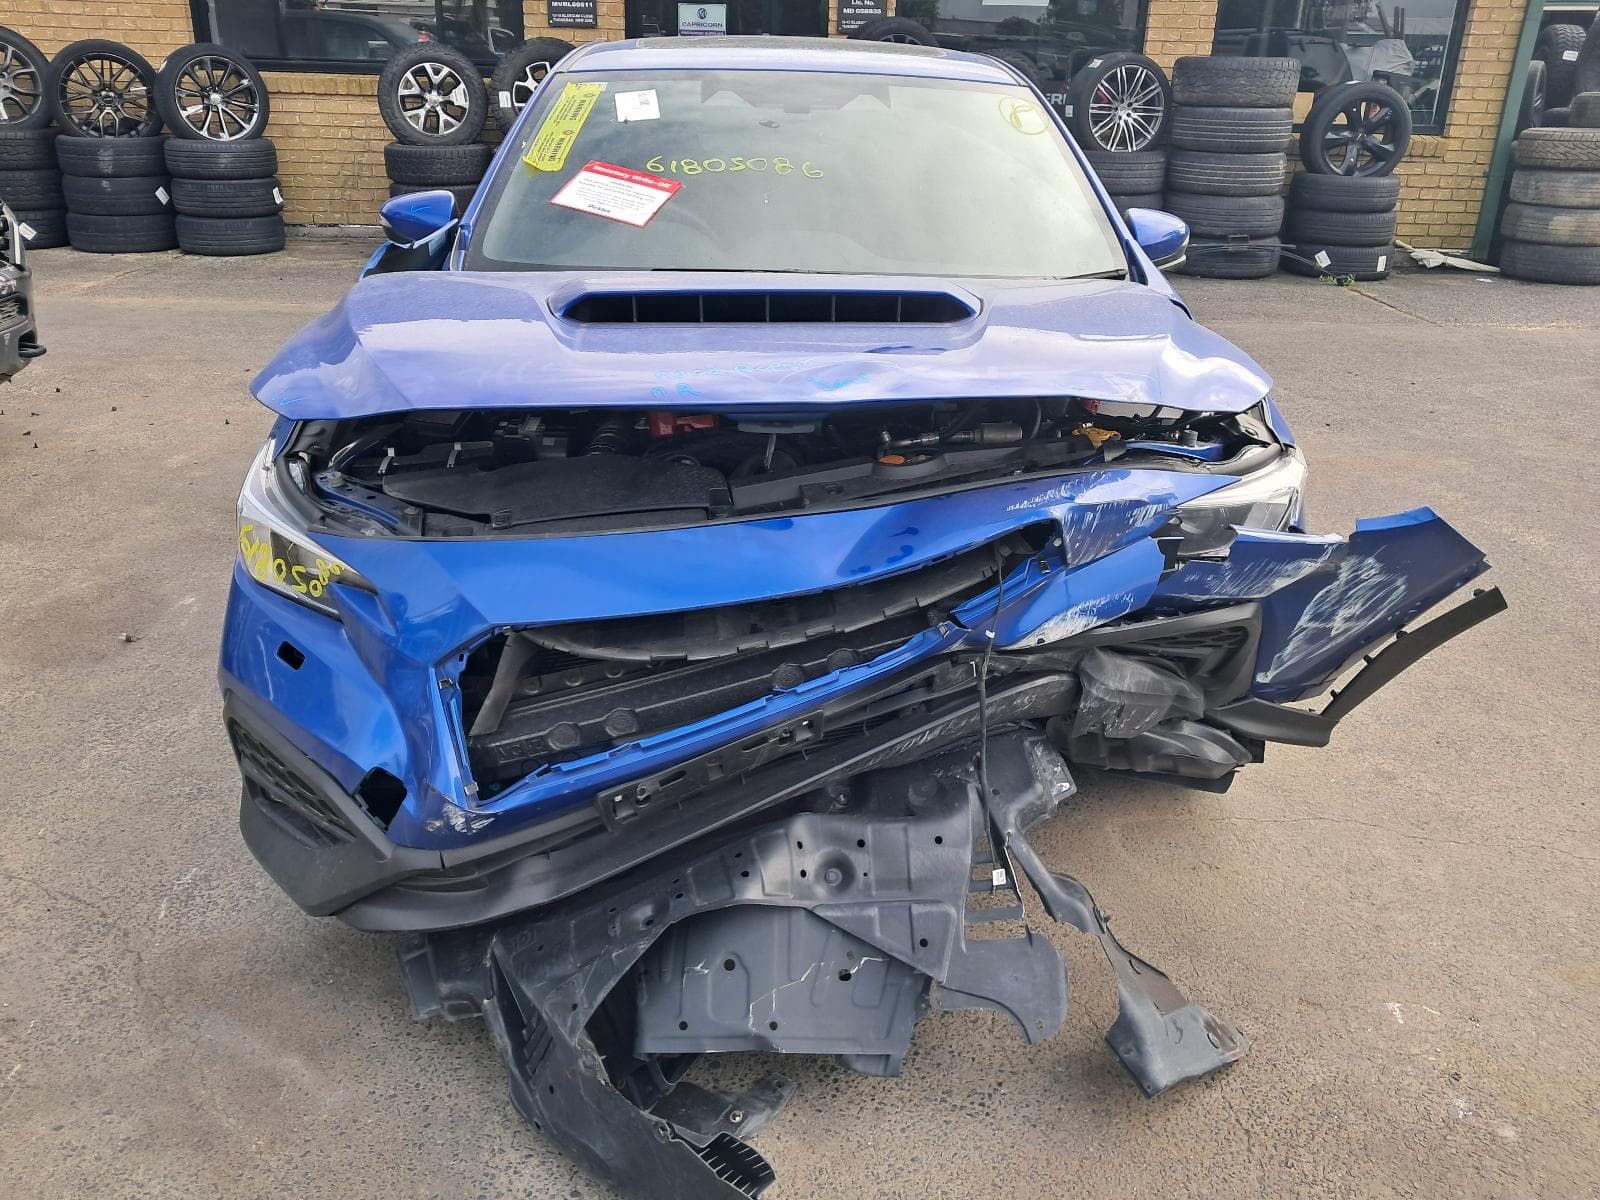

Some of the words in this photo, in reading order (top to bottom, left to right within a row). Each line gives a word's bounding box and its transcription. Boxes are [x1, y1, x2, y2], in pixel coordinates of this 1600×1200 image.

[593, 165, 631, 178] Statutory
[632, 175, 672, 189] Write-Off
[646, 155, 824, 179] 61805086
